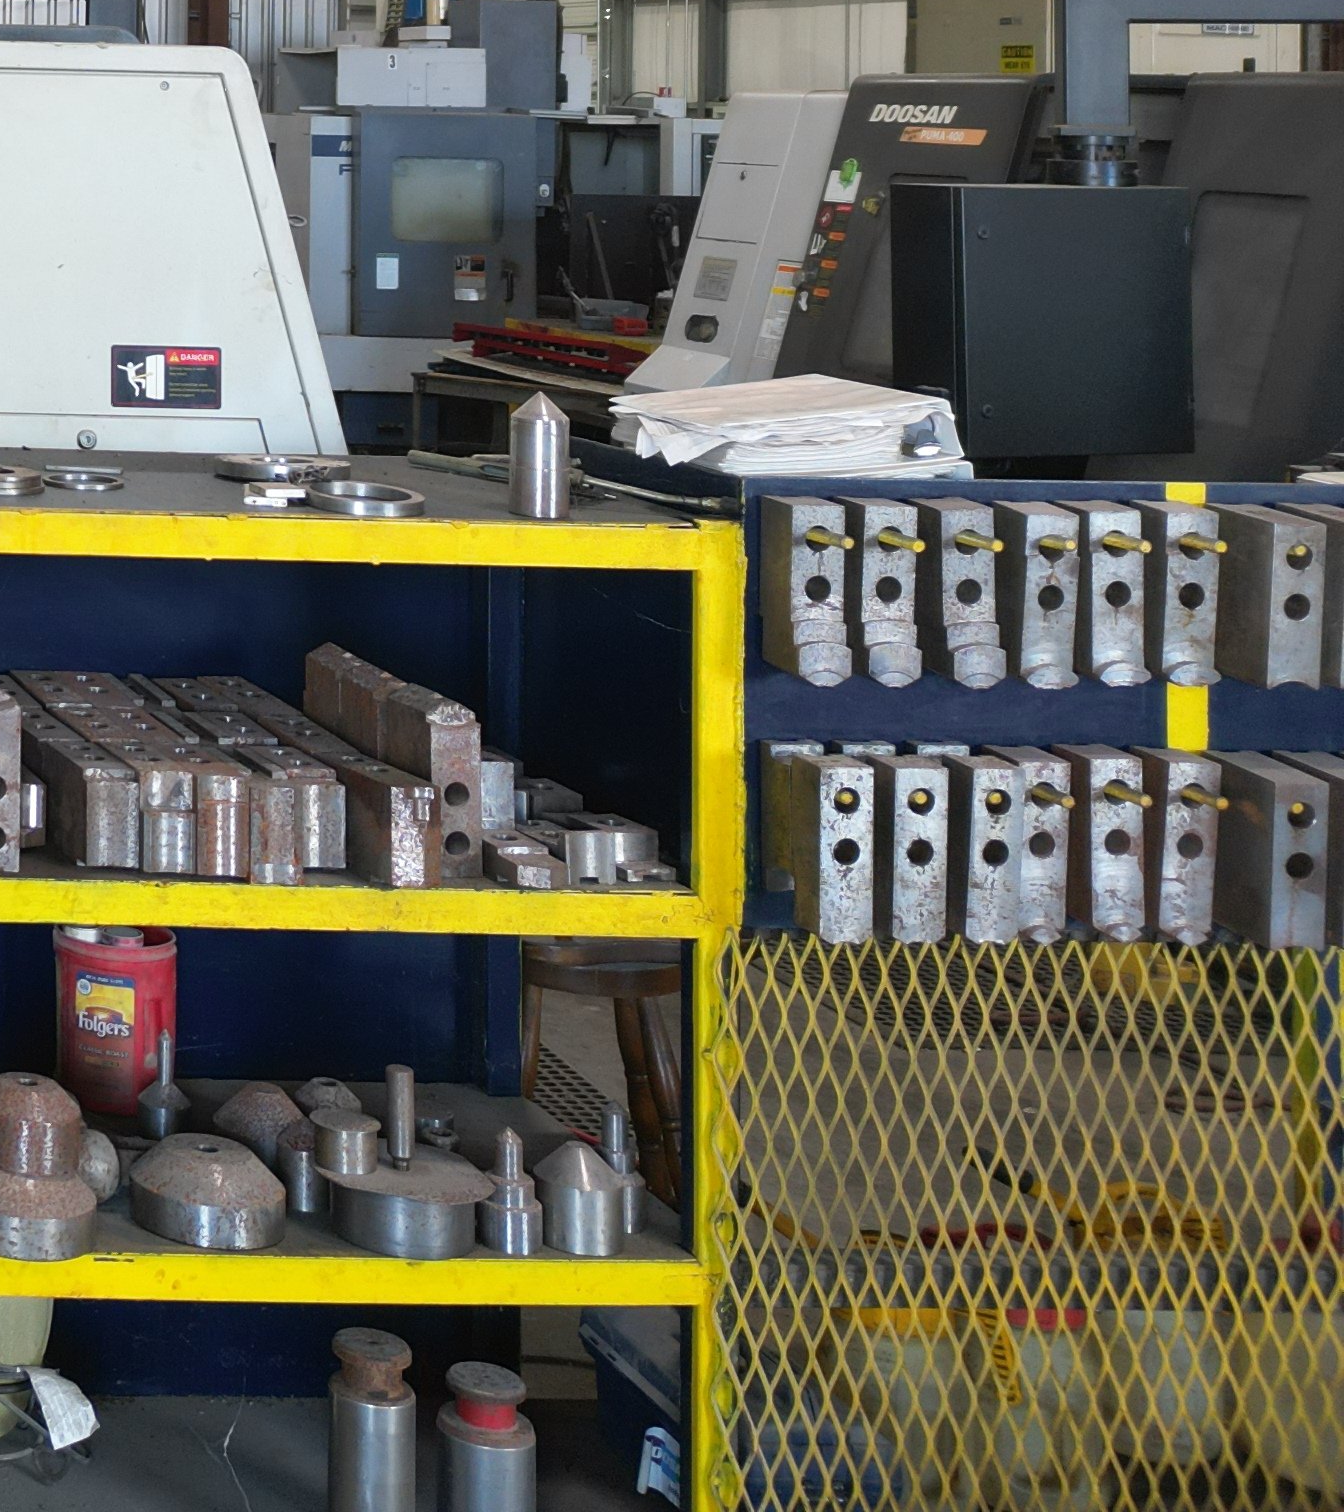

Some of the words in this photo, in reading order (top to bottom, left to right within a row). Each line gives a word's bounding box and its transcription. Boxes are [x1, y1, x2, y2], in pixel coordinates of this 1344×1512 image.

[389, 54, 396, 69] 3
[869, 104, 958, 123] DOOSAN
[920, 130, 945, 141] PUMA
[180, 353, 214, 361] DANGER
[78, 1010, 130, 1037] Folgers
